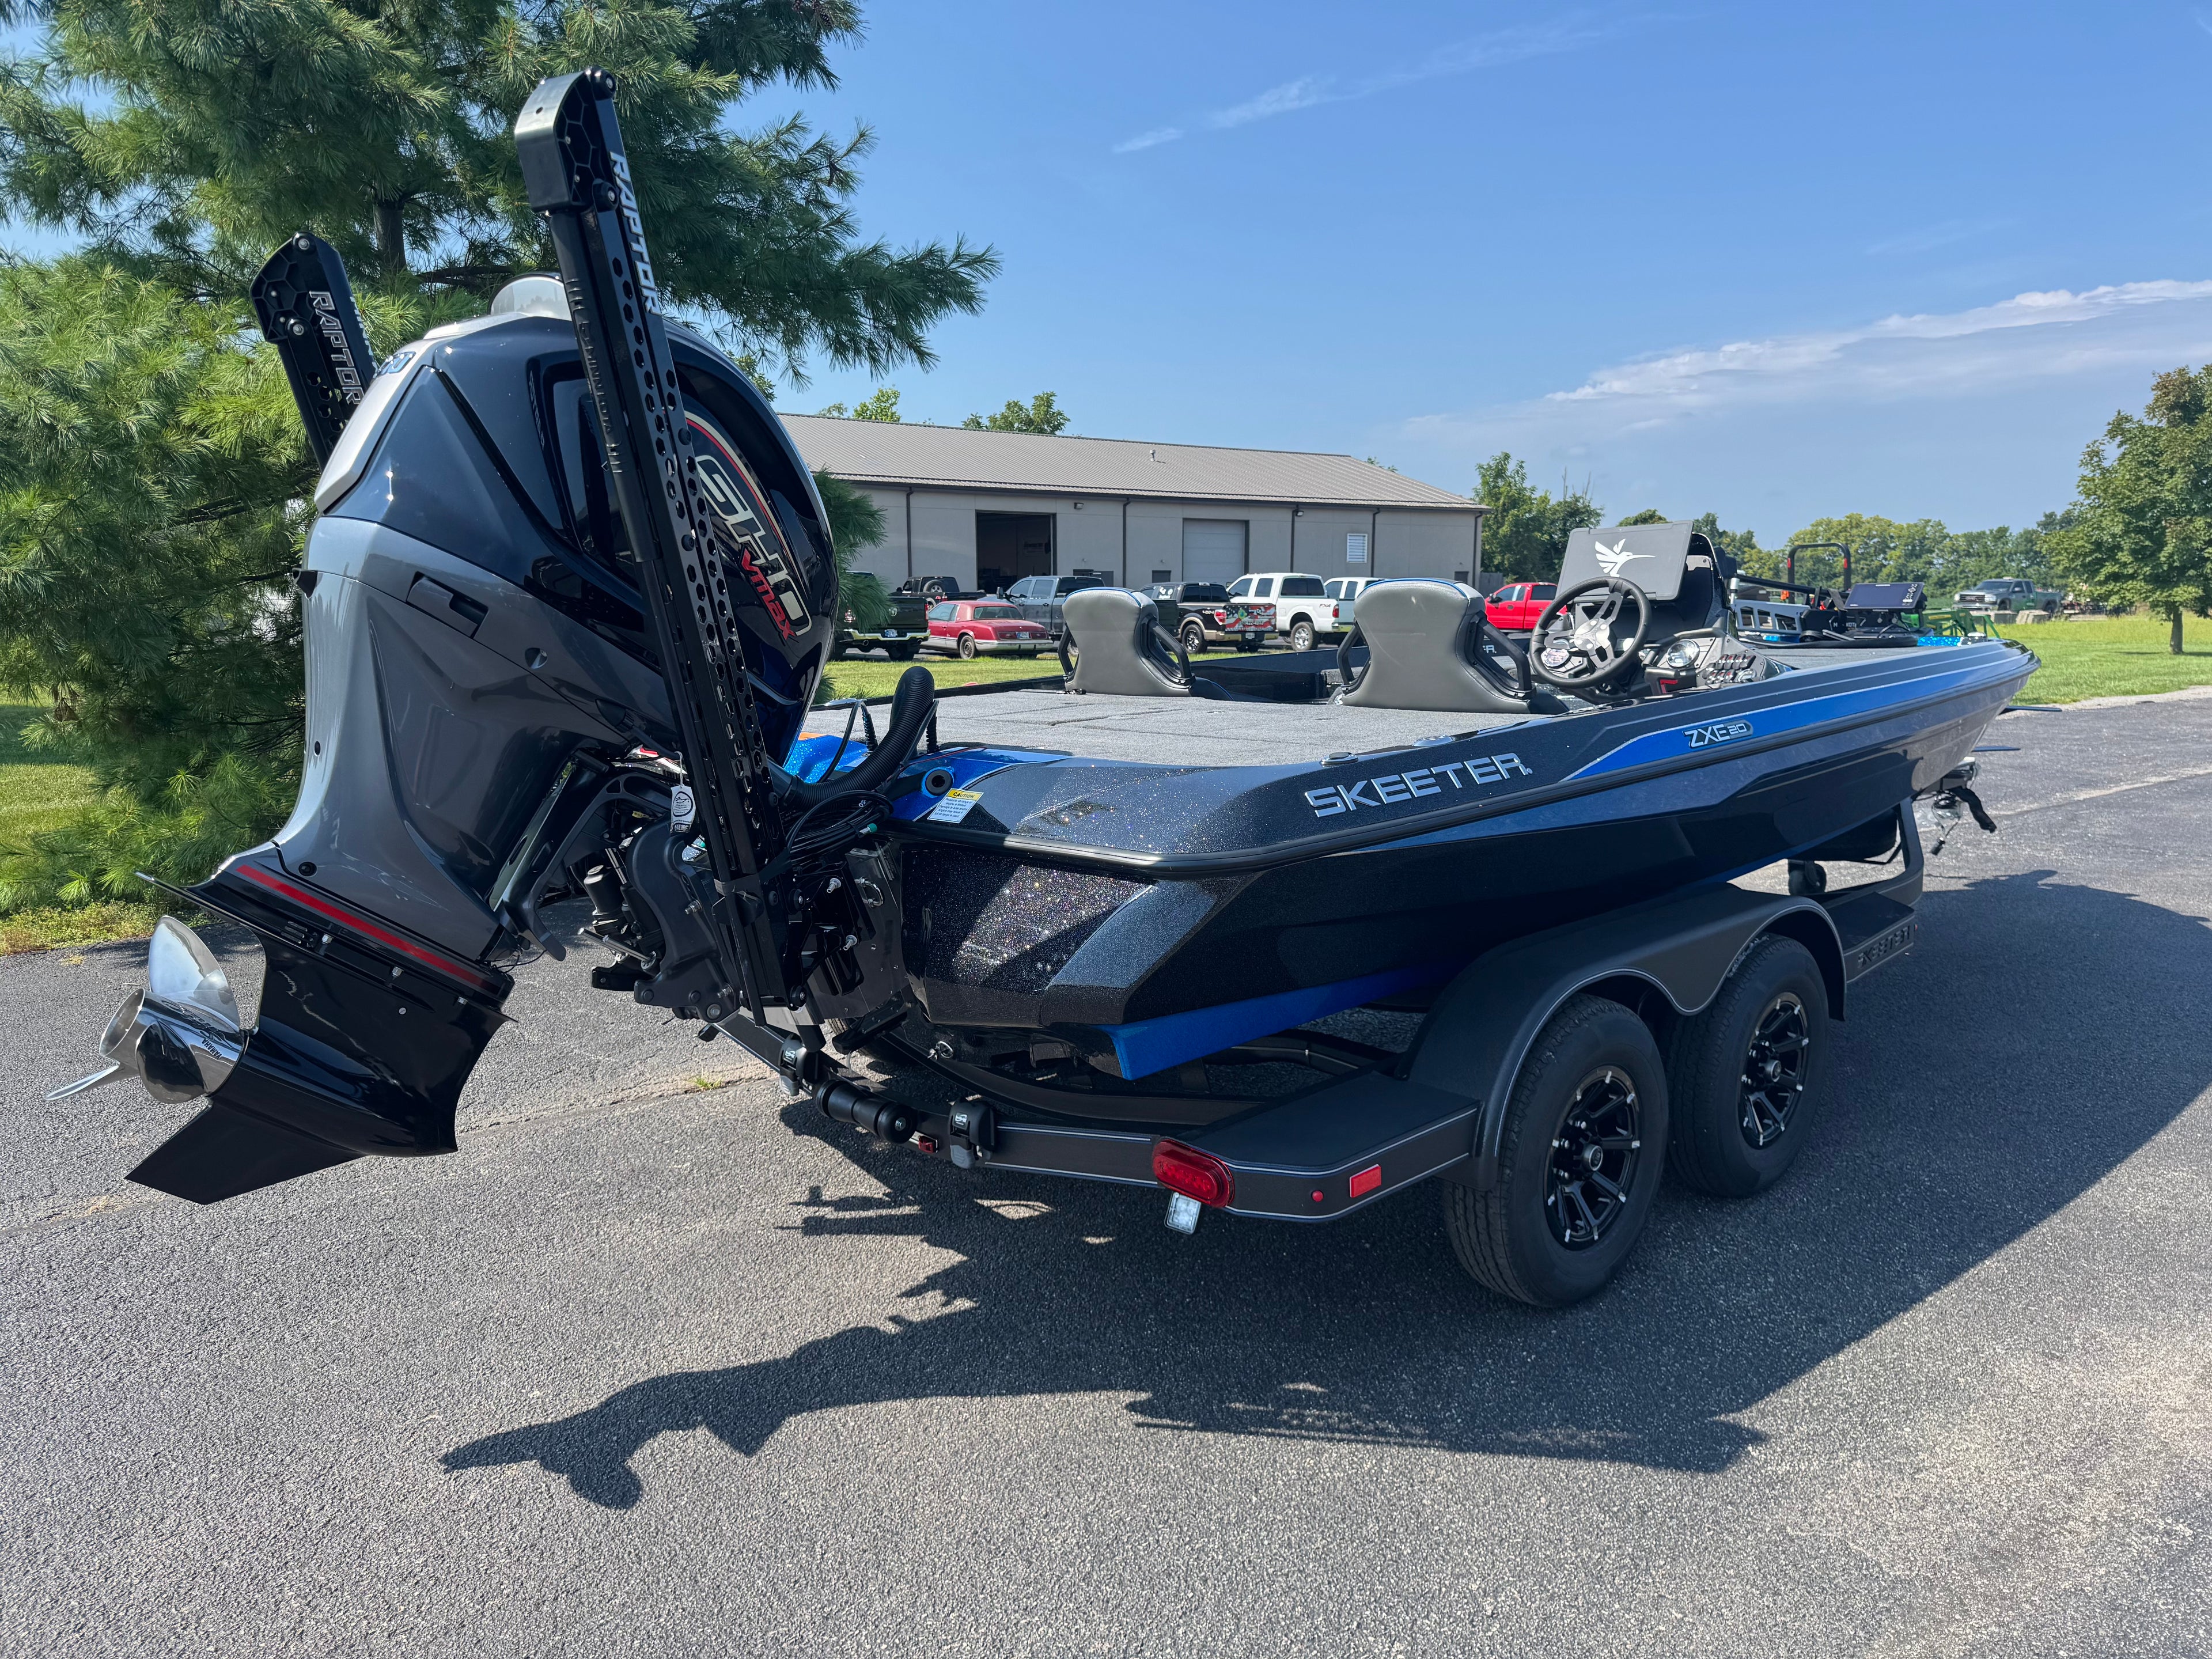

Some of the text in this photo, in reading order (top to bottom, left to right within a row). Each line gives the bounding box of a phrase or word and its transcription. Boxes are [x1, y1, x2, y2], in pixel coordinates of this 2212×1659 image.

[609, 151, 661, 316] RAPTOR
[309, 290, 364, 405] RAPTOR
[1304, 753, 1530, 818] SKEETER
[202, 1038, 222, 1059] YAMAHA
